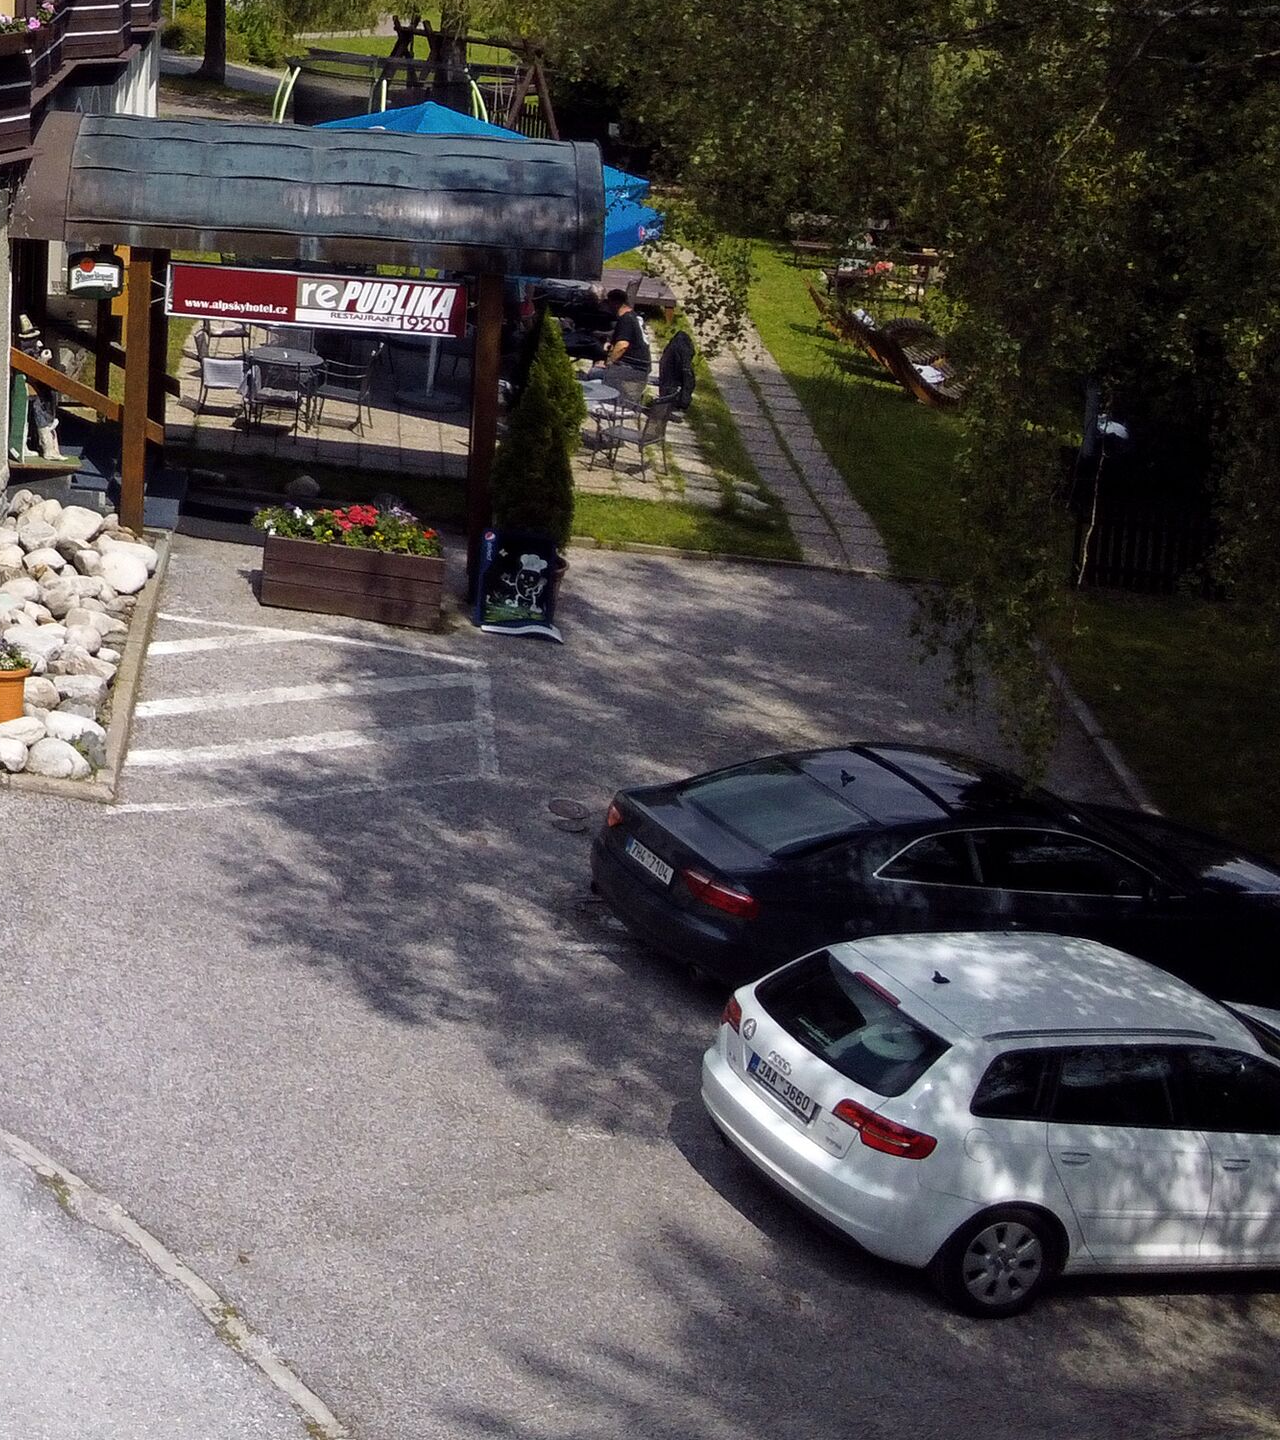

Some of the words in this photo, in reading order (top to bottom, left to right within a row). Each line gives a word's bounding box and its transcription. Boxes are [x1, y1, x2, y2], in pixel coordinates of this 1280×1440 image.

[184, 299, 289, 315] www.alpskyhotel.cz
[330, 311, 395, 323] RESTAURANT
[396, 317, 446, 332] 1920
